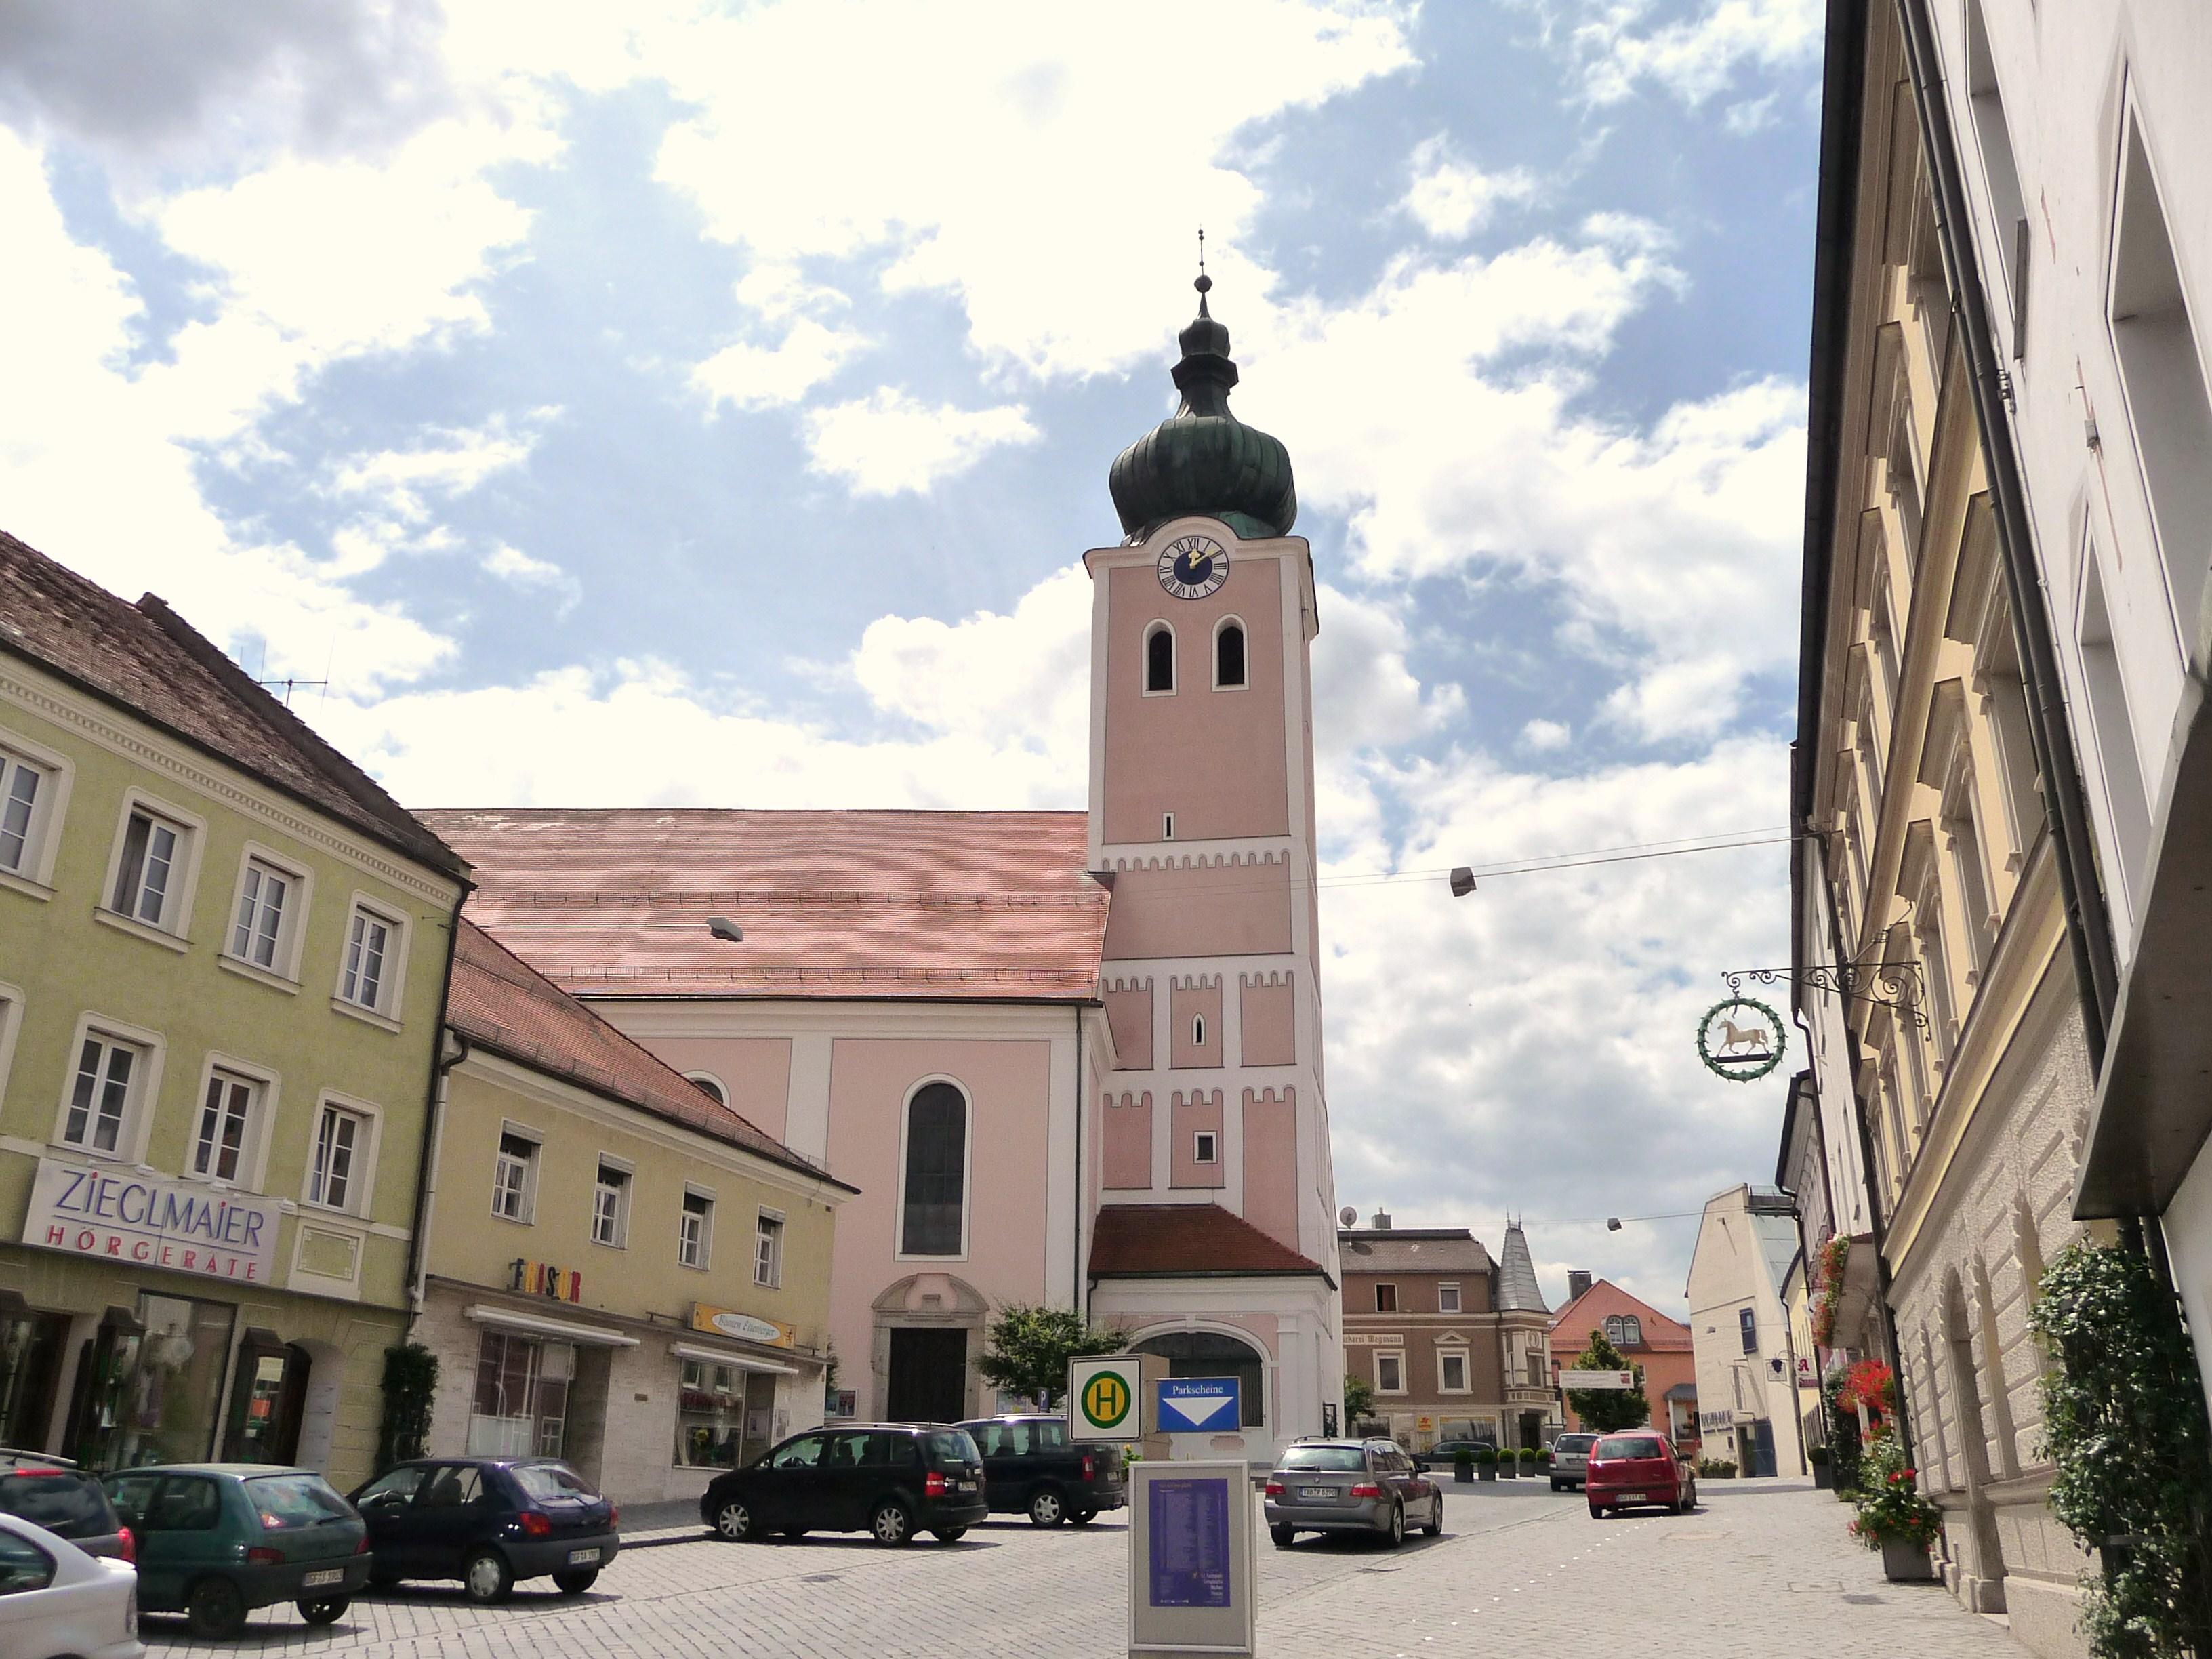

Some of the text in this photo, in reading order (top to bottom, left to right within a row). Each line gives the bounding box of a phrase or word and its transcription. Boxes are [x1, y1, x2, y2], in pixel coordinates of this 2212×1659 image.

[47, 1225, 257, 1280] HÖRGERÄTE
[1041, 1390, 1046, 1407] P
[1096, 1383, 1116, 1416] H
[1172, 1385, 1224, 1395] Parkscheine
